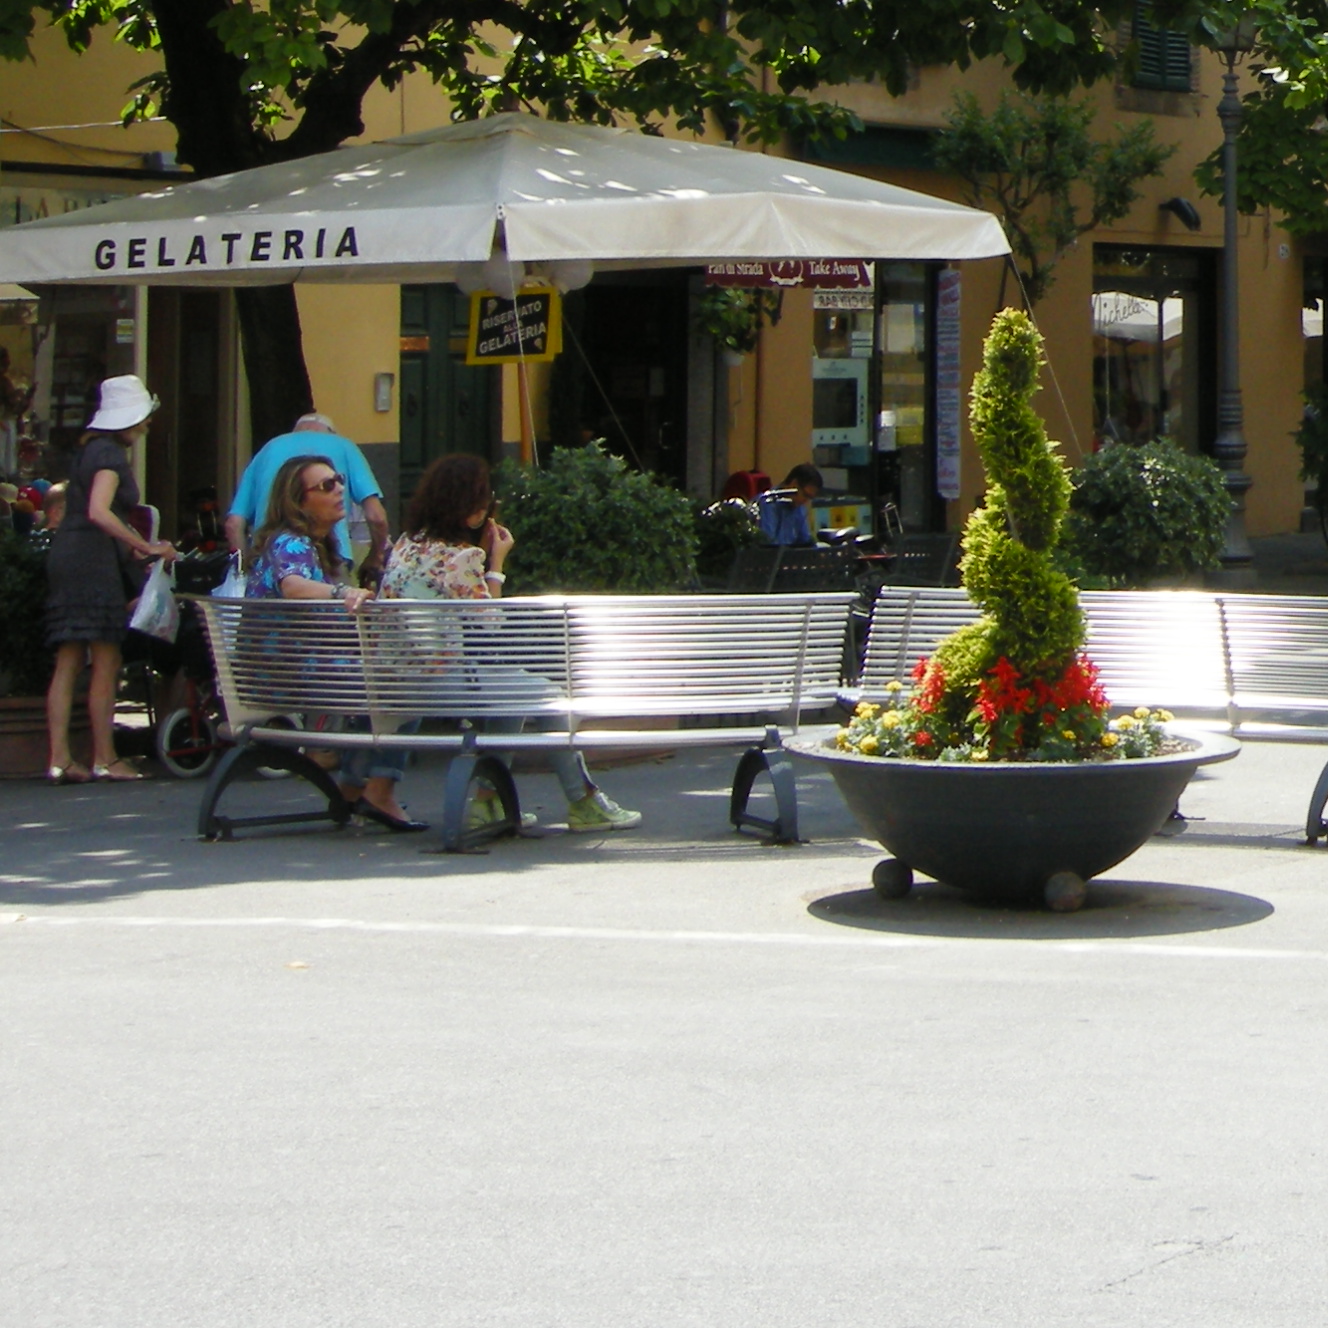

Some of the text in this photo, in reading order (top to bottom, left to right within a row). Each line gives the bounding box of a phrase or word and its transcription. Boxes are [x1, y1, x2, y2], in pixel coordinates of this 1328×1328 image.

[95, 226, 359, 270] GELATERIA
[809, 258, 860, 281] Take Away
[479, 321, 547, 354] GELATERIA
